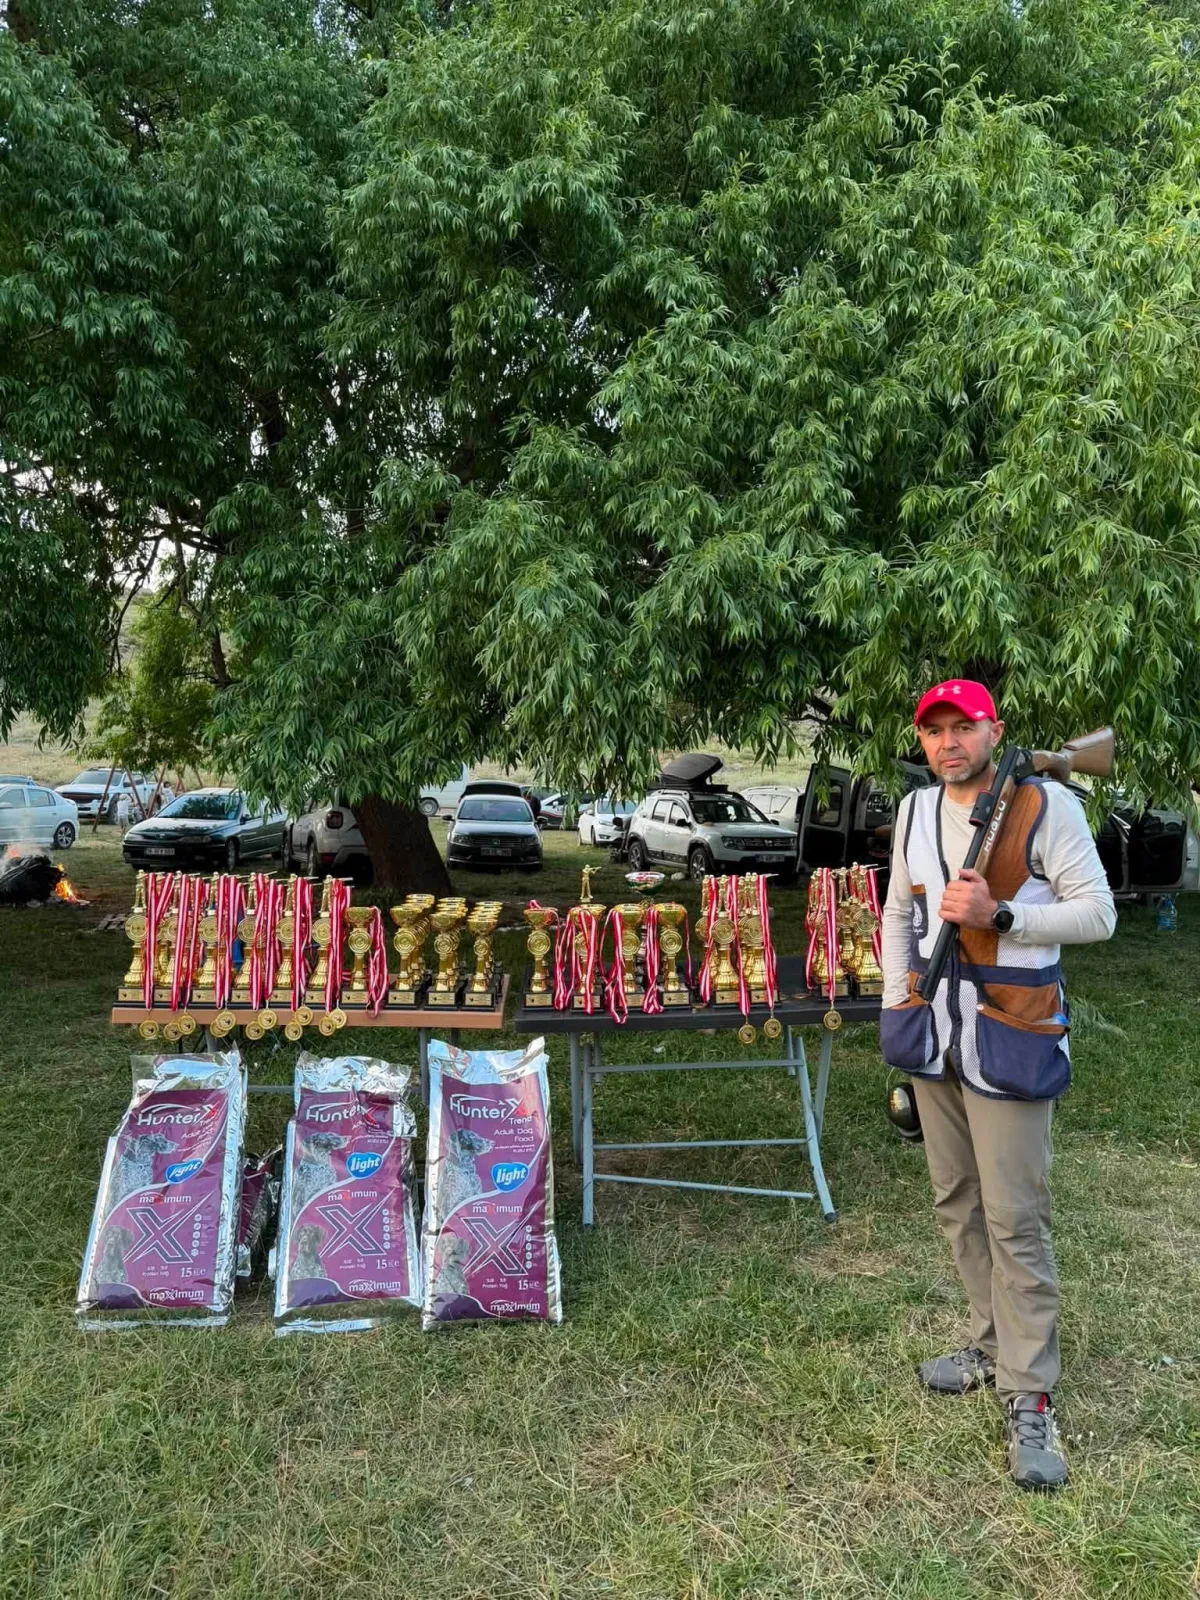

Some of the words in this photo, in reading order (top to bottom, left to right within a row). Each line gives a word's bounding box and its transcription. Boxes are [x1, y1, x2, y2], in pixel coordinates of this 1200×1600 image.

[351, 1157, 380, 1172] light
[496, 1168, 526, 1185] light
[376, 1259, 387, 1269] 15
[180, 1267, 192, 1278] 15
[518, 1280, 529, 1290] 15
